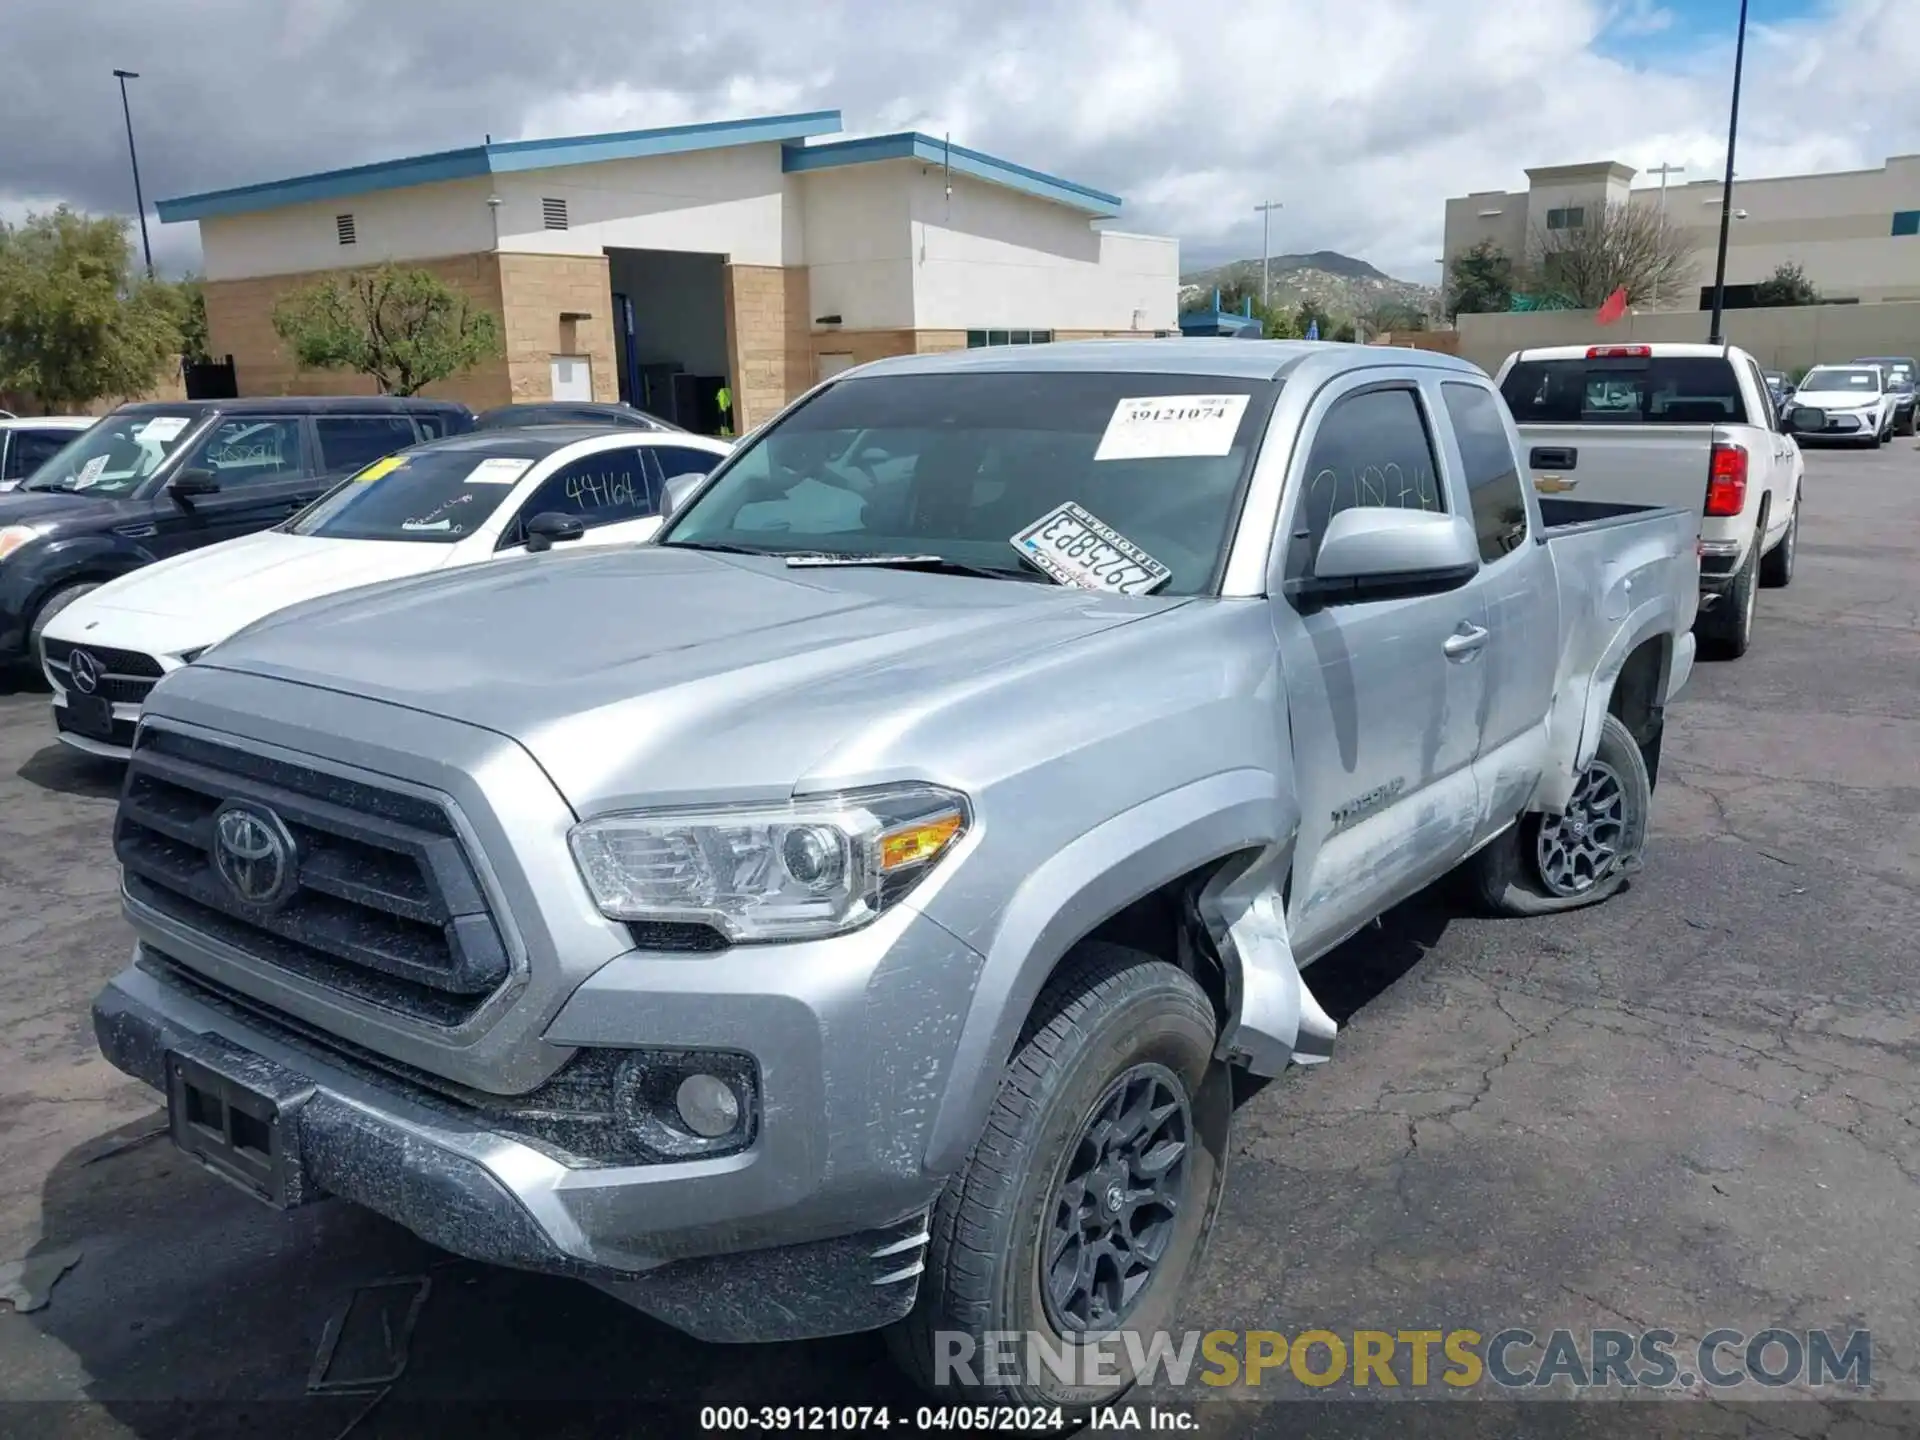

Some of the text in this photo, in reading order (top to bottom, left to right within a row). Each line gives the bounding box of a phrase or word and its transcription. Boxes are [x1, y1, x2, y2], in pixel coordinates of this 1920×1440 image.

[1131, 408, 1225, 421] 39121074
[566, 472, 637, 510] 44164
[1042, 516, 1150, 595] 29258P3
